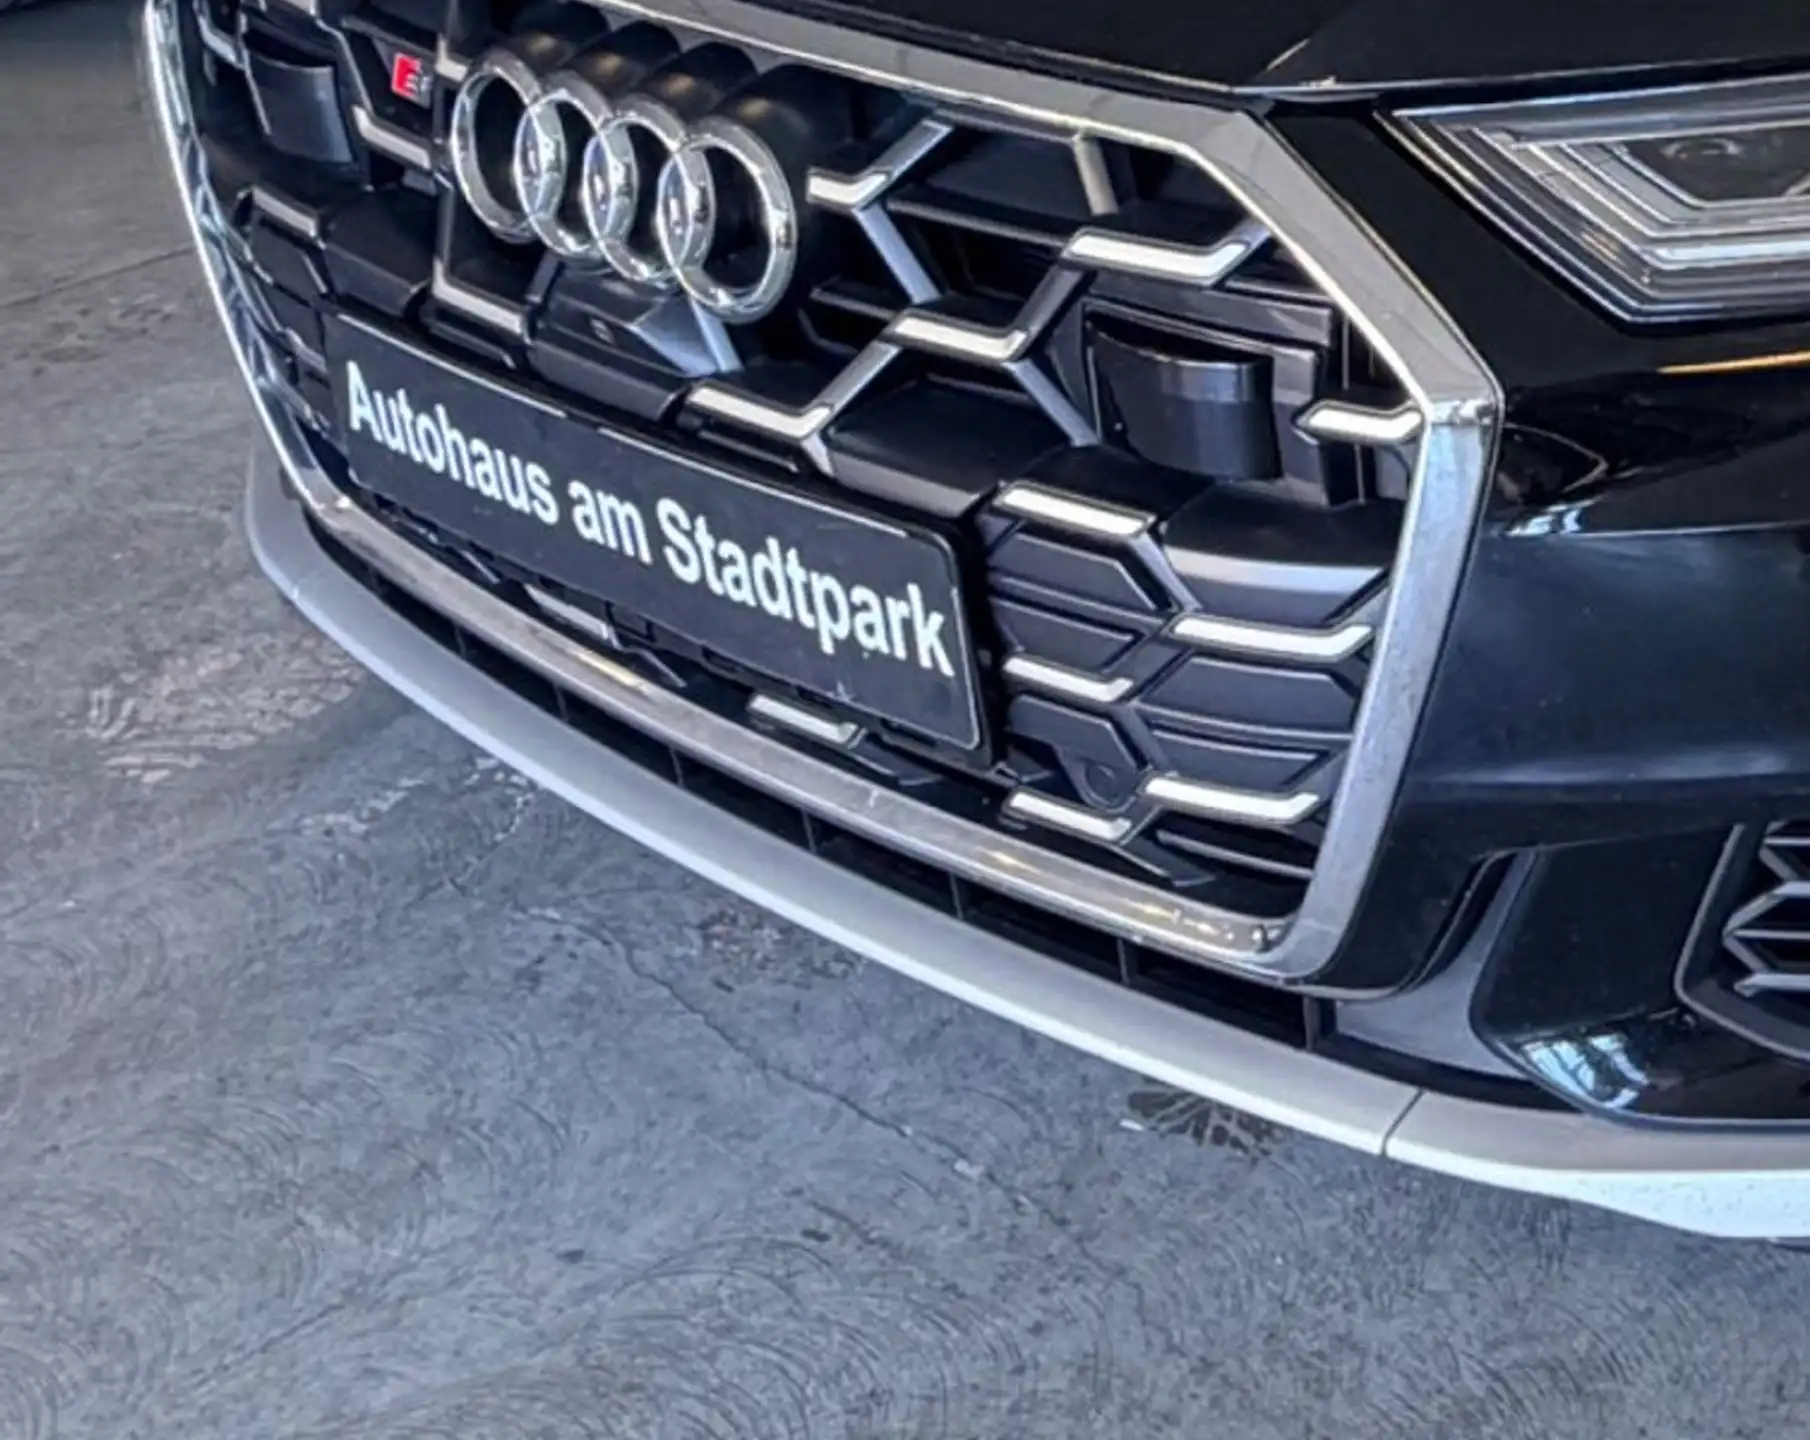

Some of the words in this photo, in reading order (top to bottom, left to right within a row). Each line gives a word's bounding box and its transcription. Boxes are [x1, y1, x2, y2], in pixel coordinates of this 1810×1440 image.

[346, 361, 559, 525] Autohaus
[567, 480, 652, 565] am
[656, 497, 954, 677] Stadtpark
